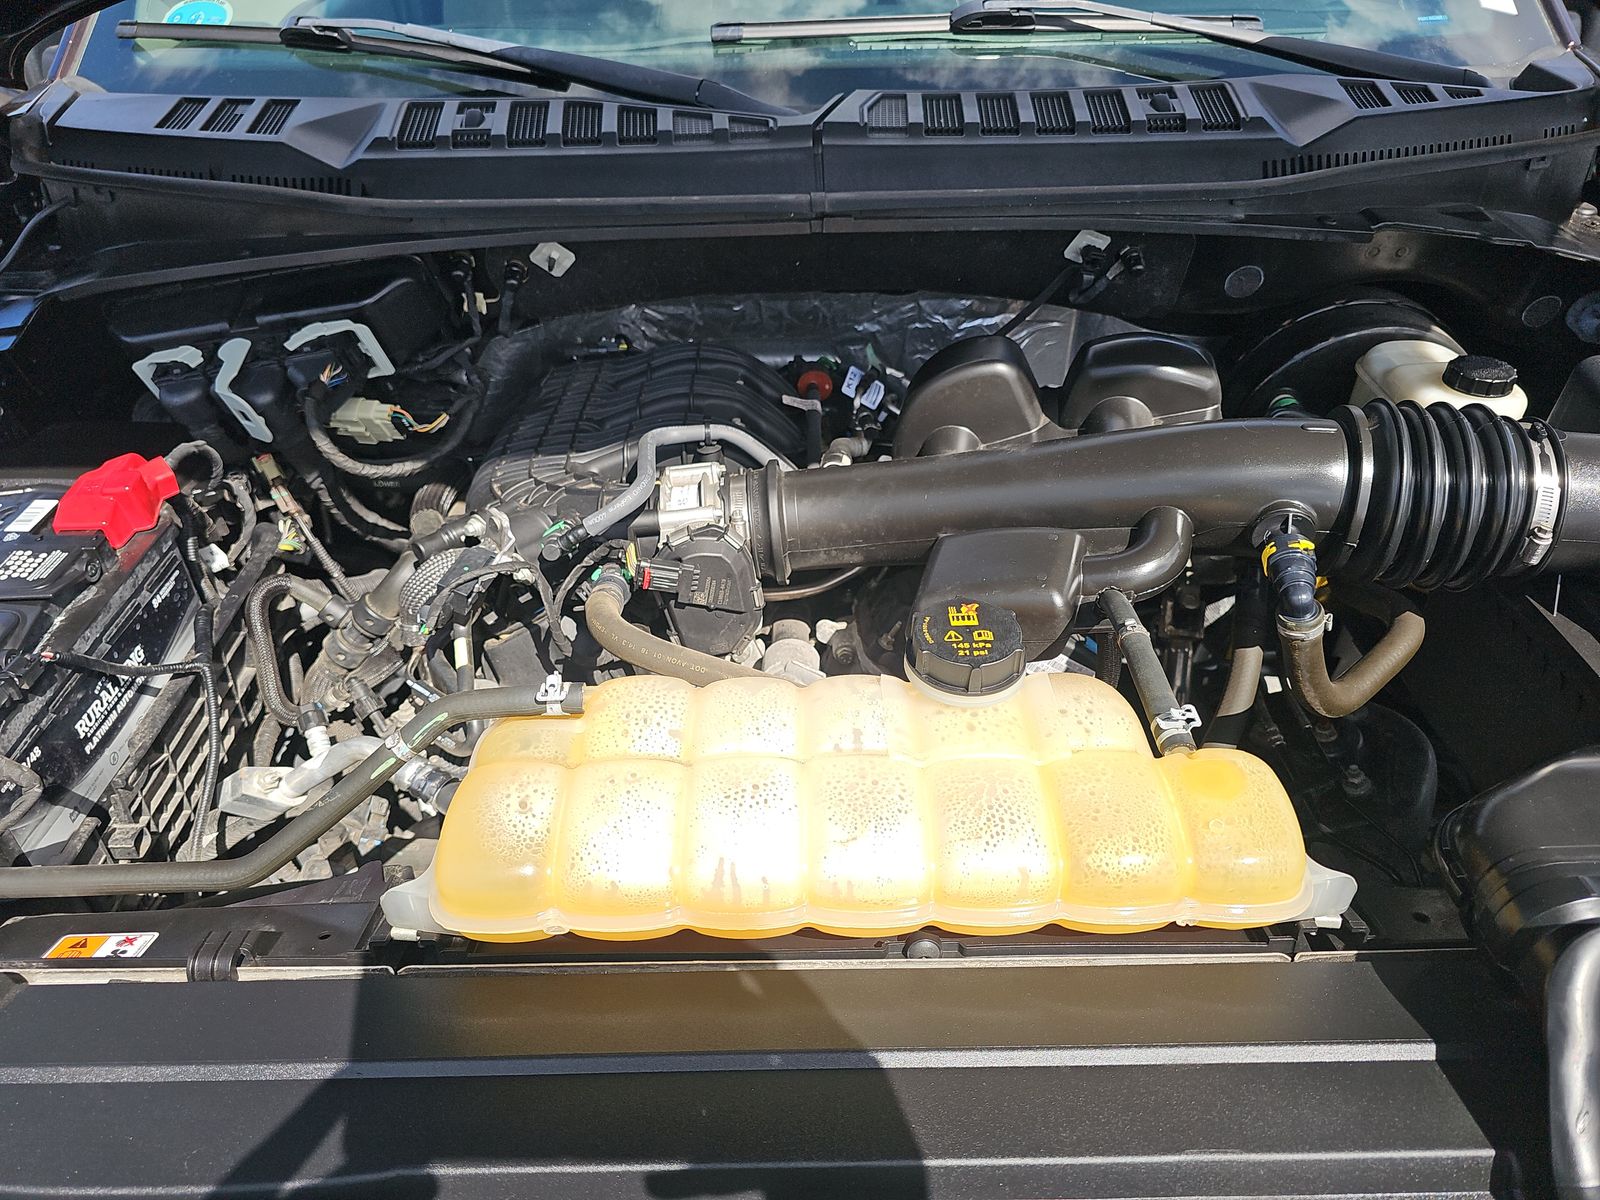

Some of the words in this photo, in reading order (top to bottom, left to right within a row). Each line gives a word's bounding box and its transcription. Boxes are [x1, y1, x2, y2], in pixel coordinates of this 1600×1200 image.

[973, 649, 989, 657] psi
[74, 682, 119, 740] RURAL
[84, 710, 118, 755] PLATINUM
